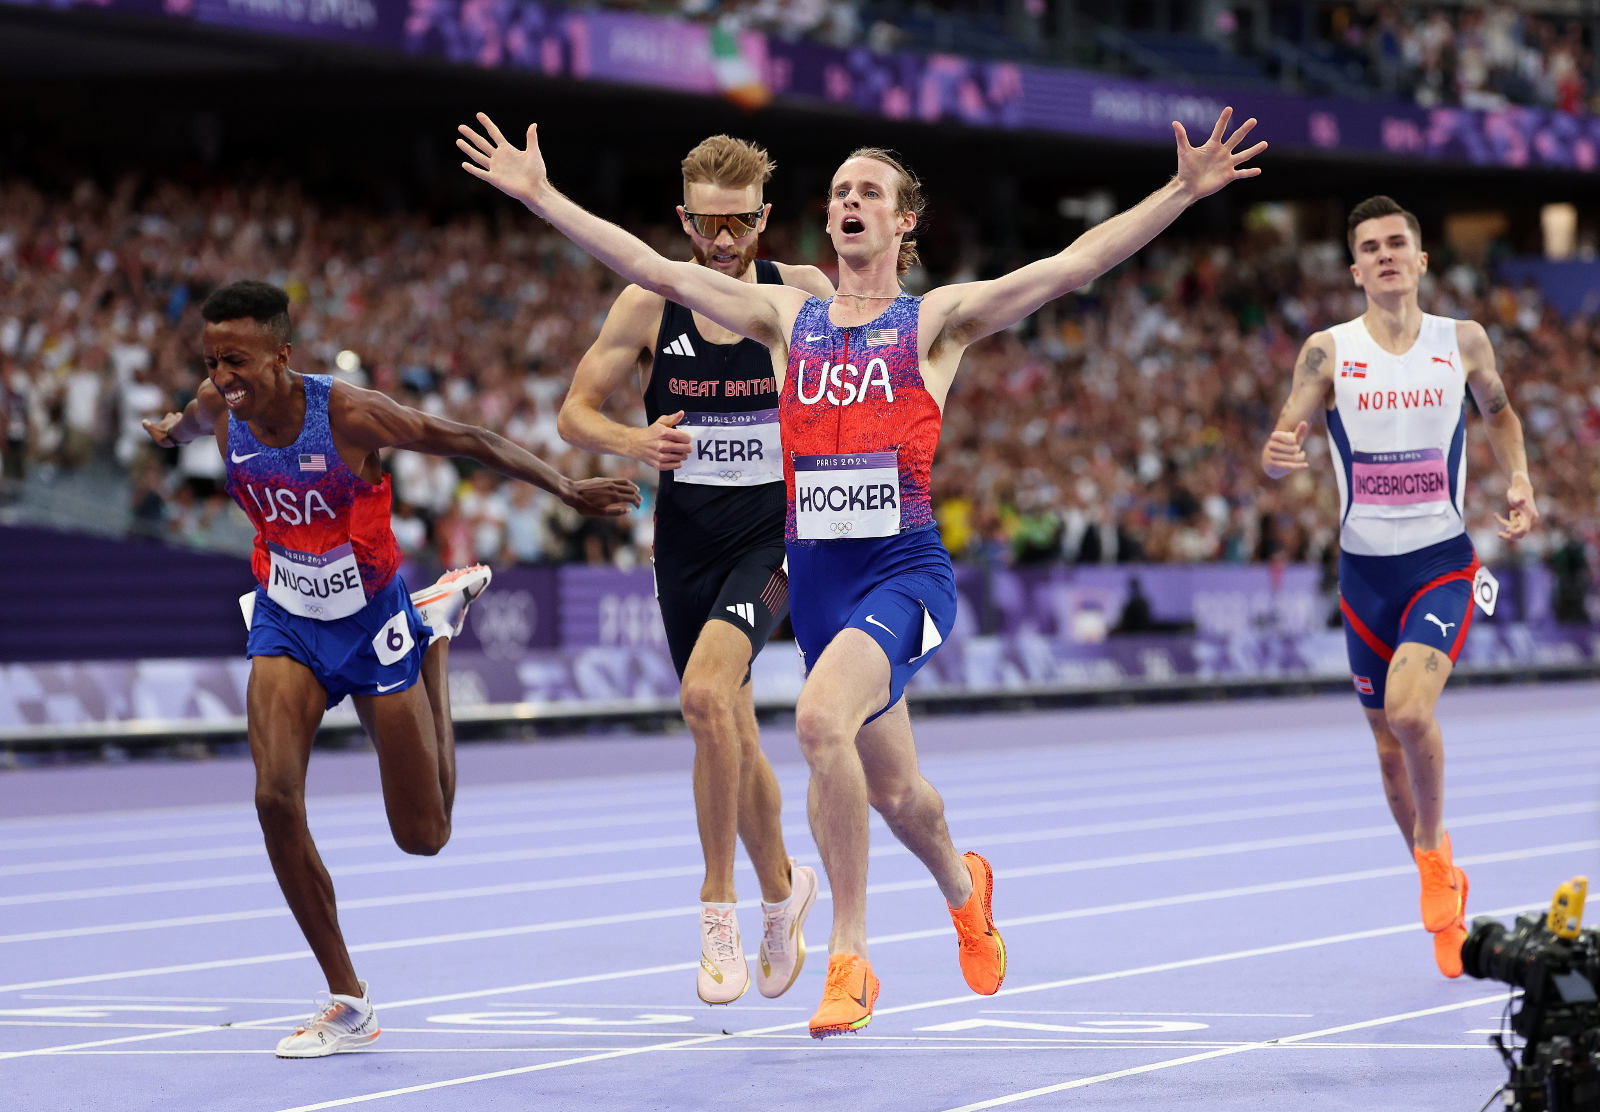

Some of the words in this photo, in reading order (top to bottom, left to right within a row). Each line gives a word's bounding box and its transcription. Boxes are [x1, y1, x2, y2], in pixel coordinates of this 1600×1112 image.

[669, 377, 720, 397] GREAT
[724, 376, 777, 397] BRITAI
[797, 357, 894, 406] USA
[1358, 388, 1444, 411] NORWAY
[701, 415, 730, 423] PARIS
[731, 414, 757, 424] 2024
[697, 438, 764, 462] KERR
[816, 458, 839, 467] PARIS
[841, 457, 868, 467] 2024
[1372, 453, 1397, 462] PARIS
[1355, 471, 1444, 495] INGEBRIGTSEN
[247, 483, 336, 526] USA
[799, 483, 897, 513] HOCKER
[284, 549, 306, 561] PARIS
[307, 556, 328, 566] 2024
[273, 564, 359, 598] NUGUSE
[386, 626, 404, 652] 6
